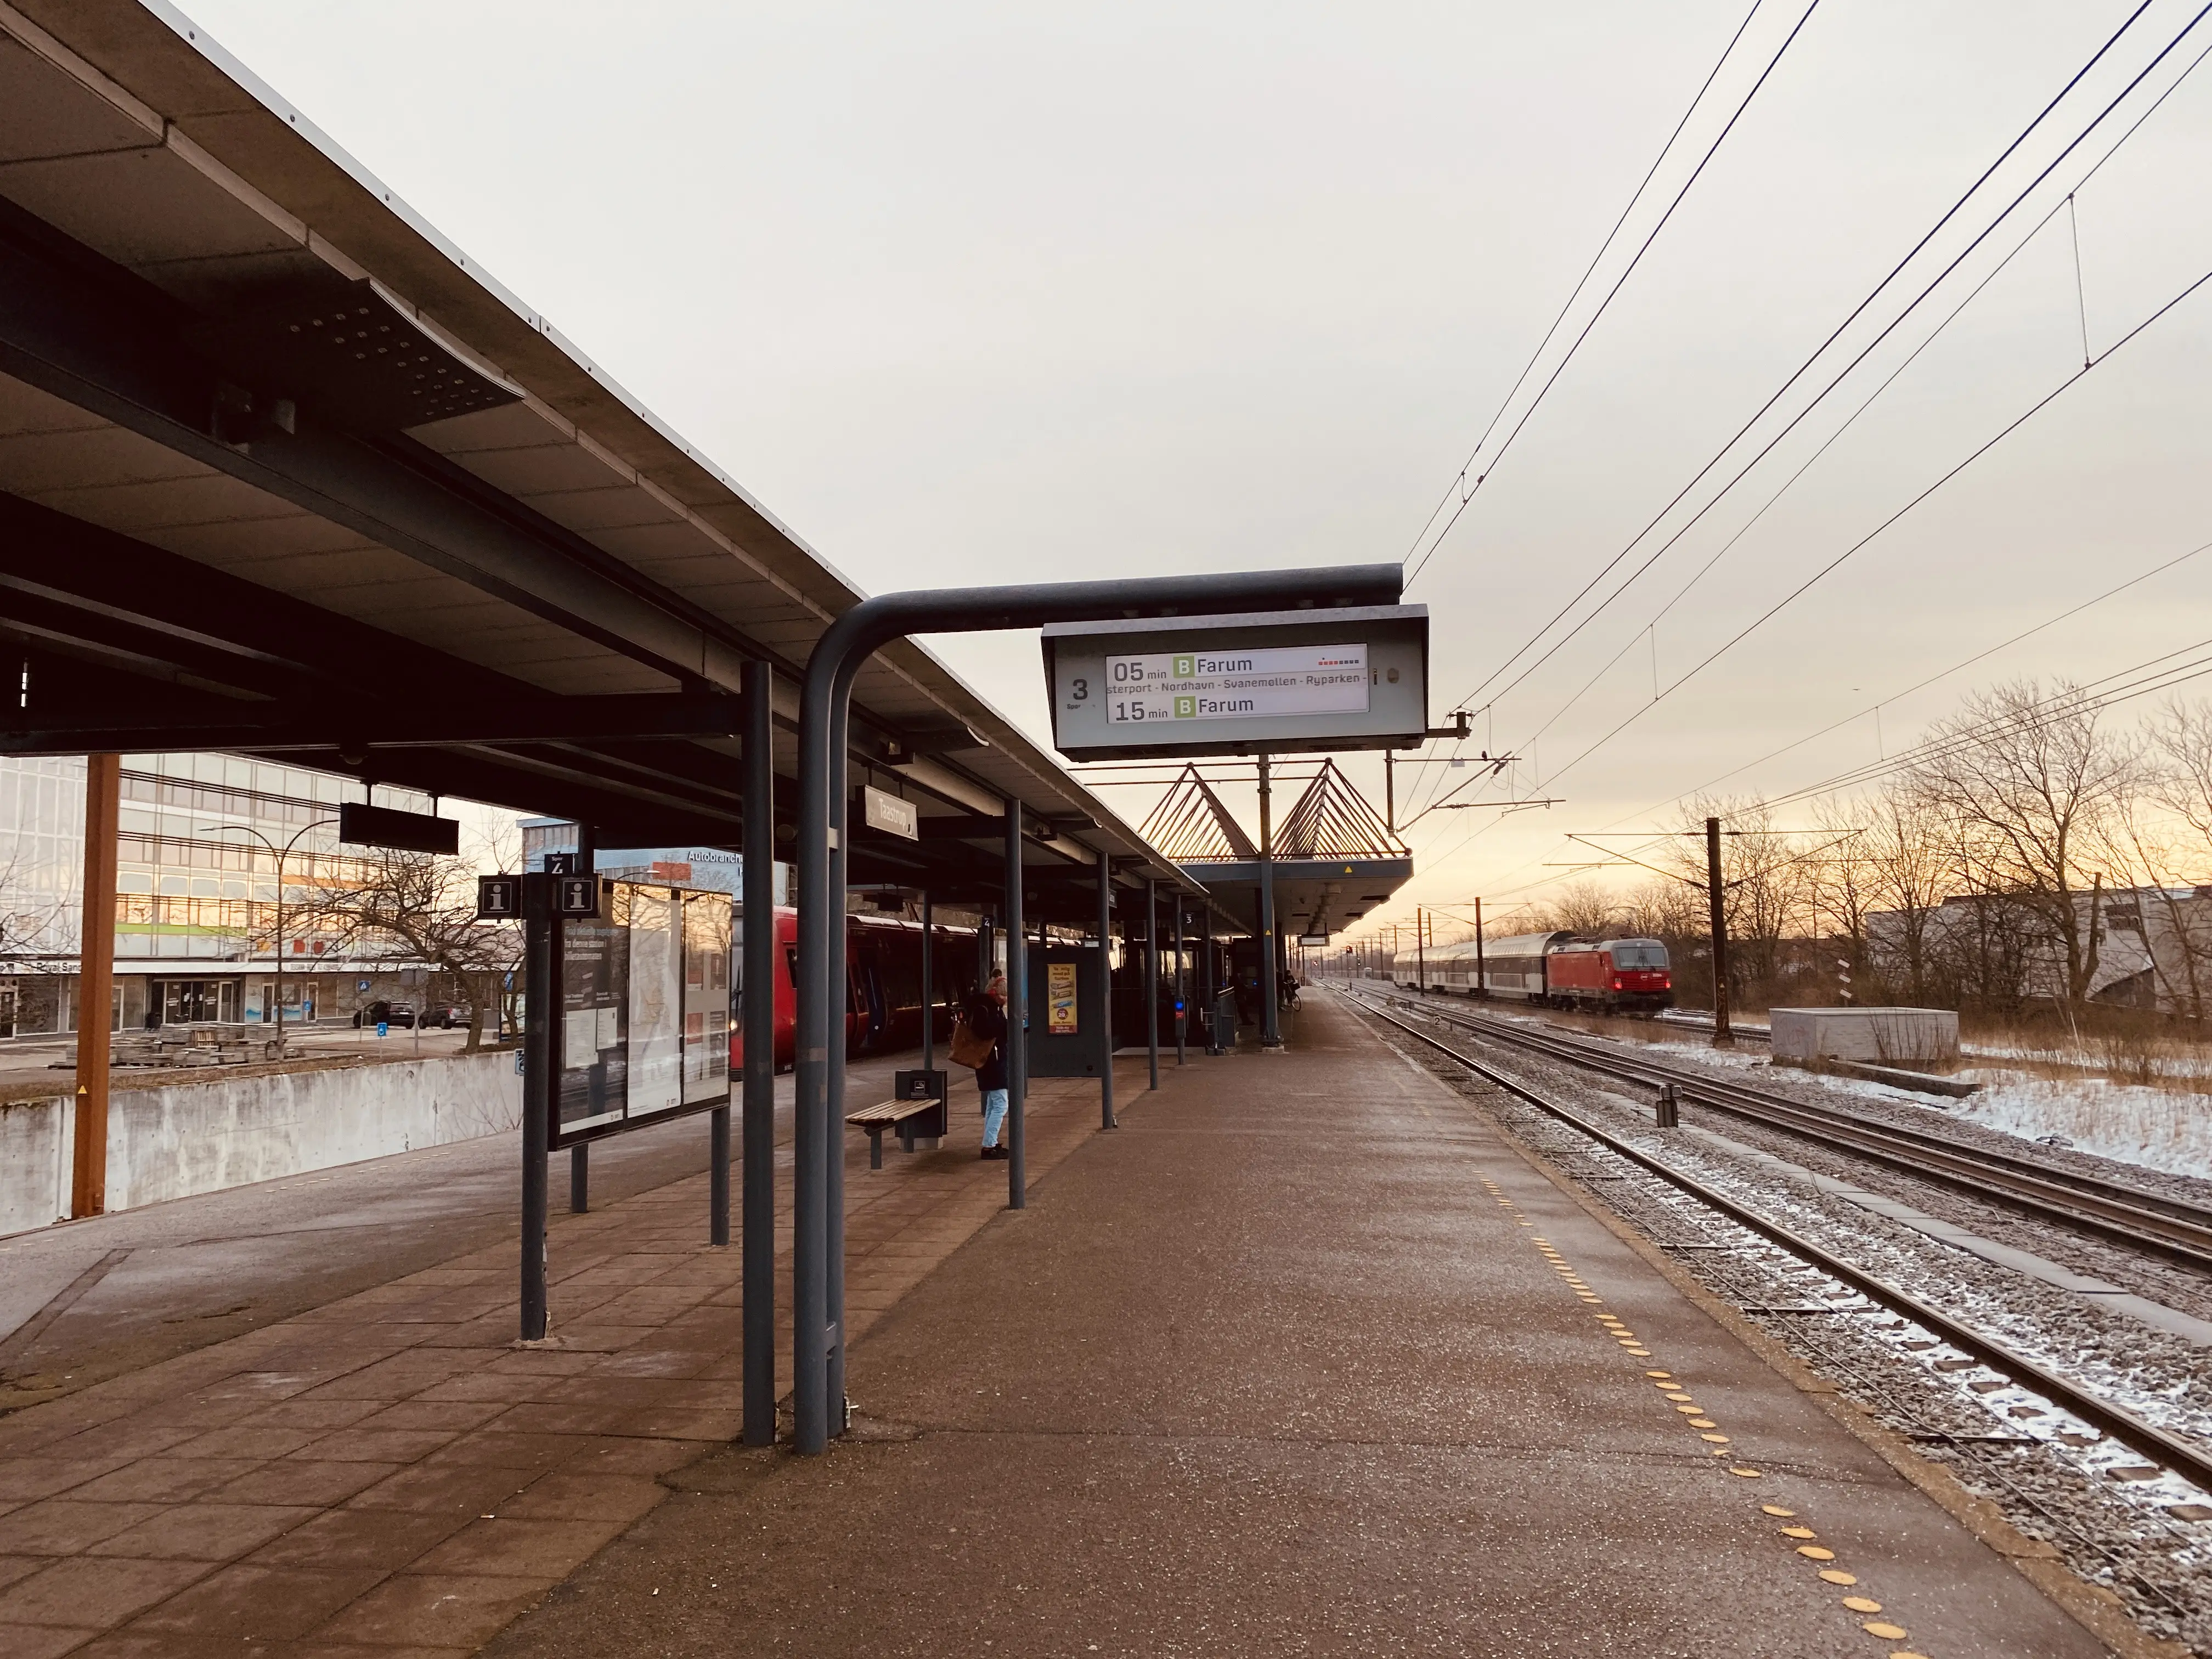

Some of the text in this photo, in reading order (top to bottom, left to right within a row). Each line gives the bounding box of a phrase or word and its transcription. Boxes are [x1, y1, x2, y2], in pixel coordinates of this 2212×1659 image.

[1114, 659, 1252, 681] 05 min B Farum
[1073, 679, 1088, 700] 3
[1107, 683, 1152, 695] sterport
[1161, 681, 1214, 692] Nordhavn
[1306, 674, 1360, 686] Ryparken
[1116, 699, 1254, 721] 15 min B Farum
[879, 798, 906, 831] Taastrup
[1435, 1017, 1440, 1025] 2
